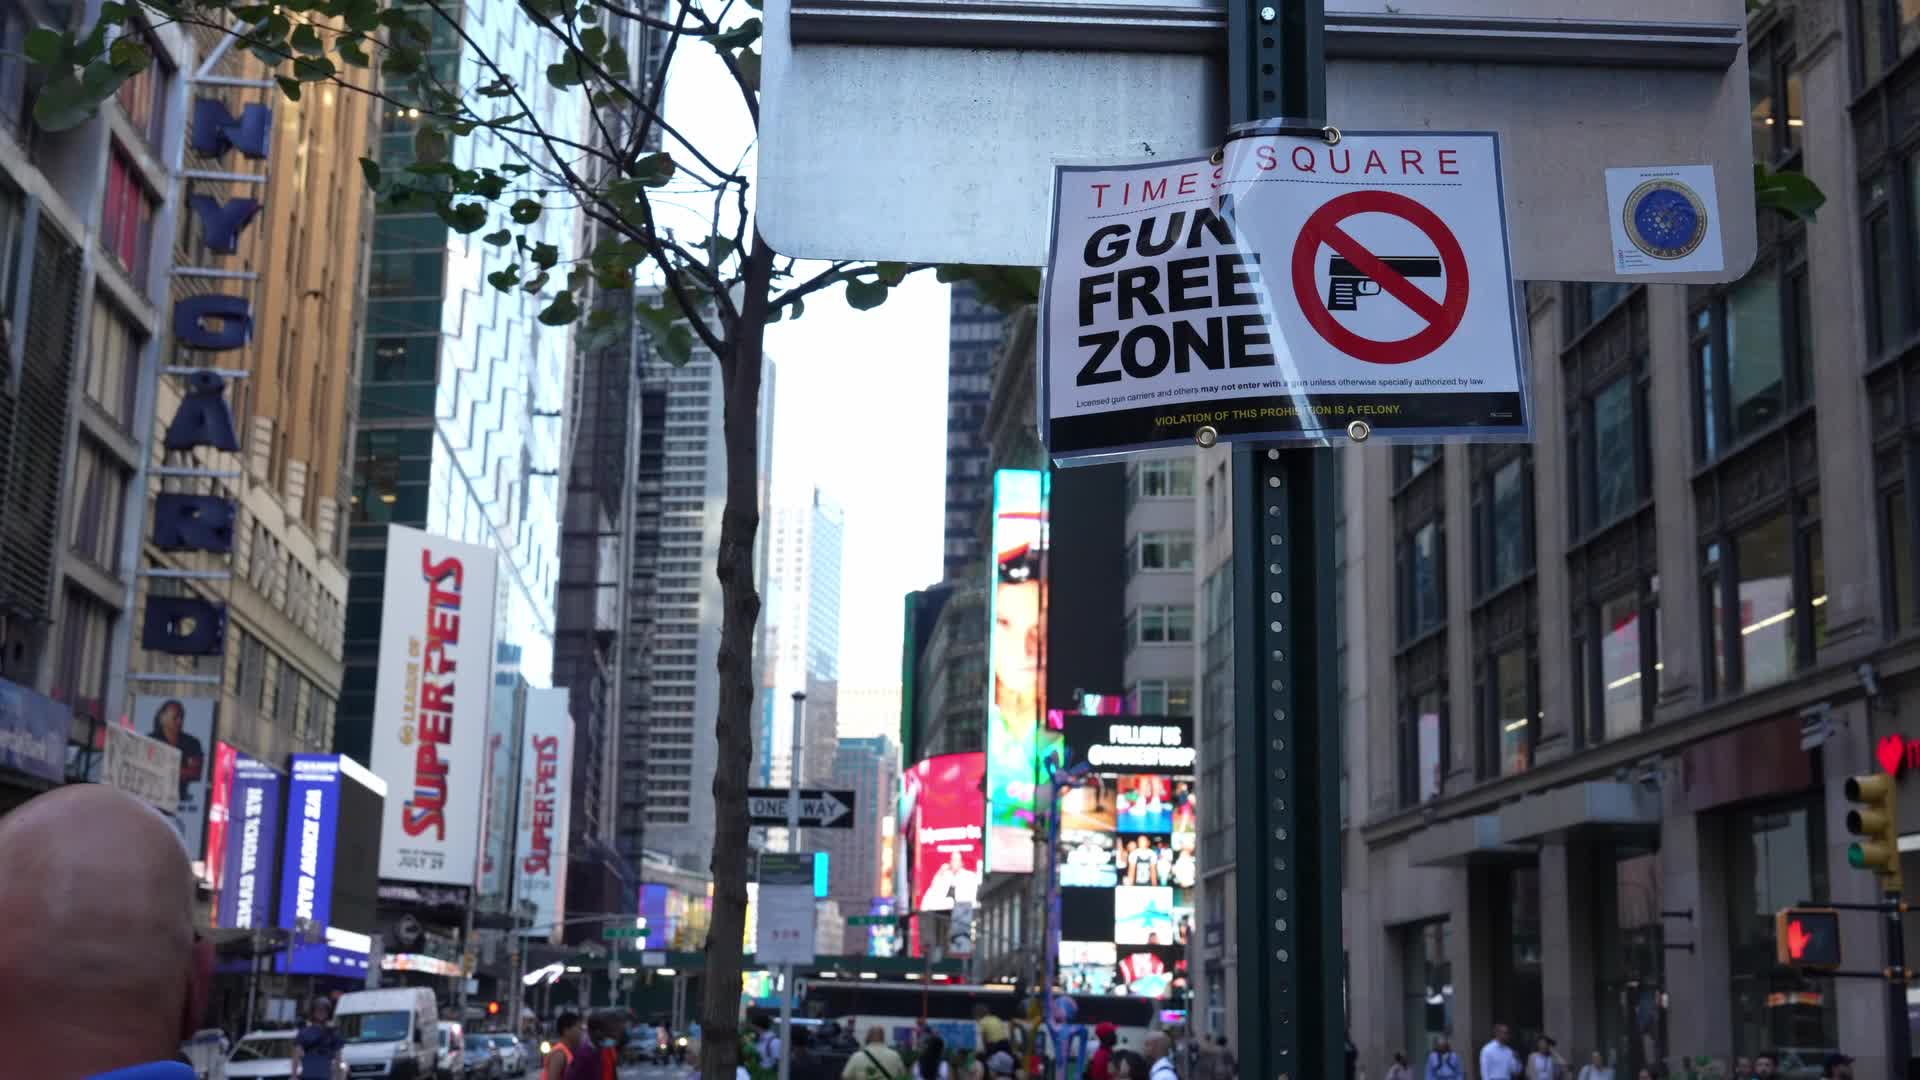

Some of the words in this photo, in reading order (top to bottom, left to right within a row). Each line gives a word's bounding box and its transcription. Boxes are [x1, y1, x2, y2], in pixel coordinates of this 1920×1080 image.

[1091, 168, 1224, 209] TIMES
[1256, 145, 1460, 175] SQUARE
[1083, 194, 1236, 267] GUN
[1079, 253, 1264, 327] FREE
[1076, 314, 1275, 387] ZONE
[1076, 398, 1110, 408] Licensed
[1111, 396, 1126, 405] gun
[1127, 391, 1156, 401] carriers
[1157, 389, 1172, 397] and
[1174, 386, 1199, 396] others
[1200, 385, 1219, 393] may
[1221, 383, 1236, 391] not
[1237, 381, 1261, 390] enter
[1262, 380, 1281, 389] with
[1310, 378, 1337, 386] unless
[1338, 378, 1377, 386] otherwise
[1378, 378, 1413, 388] specially
[1414, 378, 1457, 386] authorized
[1458, 378, 1468, 388] by
[1155, 412, 1212, 426] VIOLATION
[1214, 410, 1230, 421] OF
[1232, 408, 1258, 418] THIS
[1260, 404, 1332, 416] PROHIBTION
[1334, 405, 1345, 415] IS
[1346, 405, 1355, 415] A
[1357, 405, 1402, 415] FELONY.
[1109, 725, 1161, 745] FOLLOW
[1162, 726, 1182, 746] US
[304, 789, 322, 820] WE
[753, 799, 786, 817] ONE
[803, 799, 838, 817] WAY
[398, 856, 426, 869] JULY
[296, 875, 315, 921] GAM
